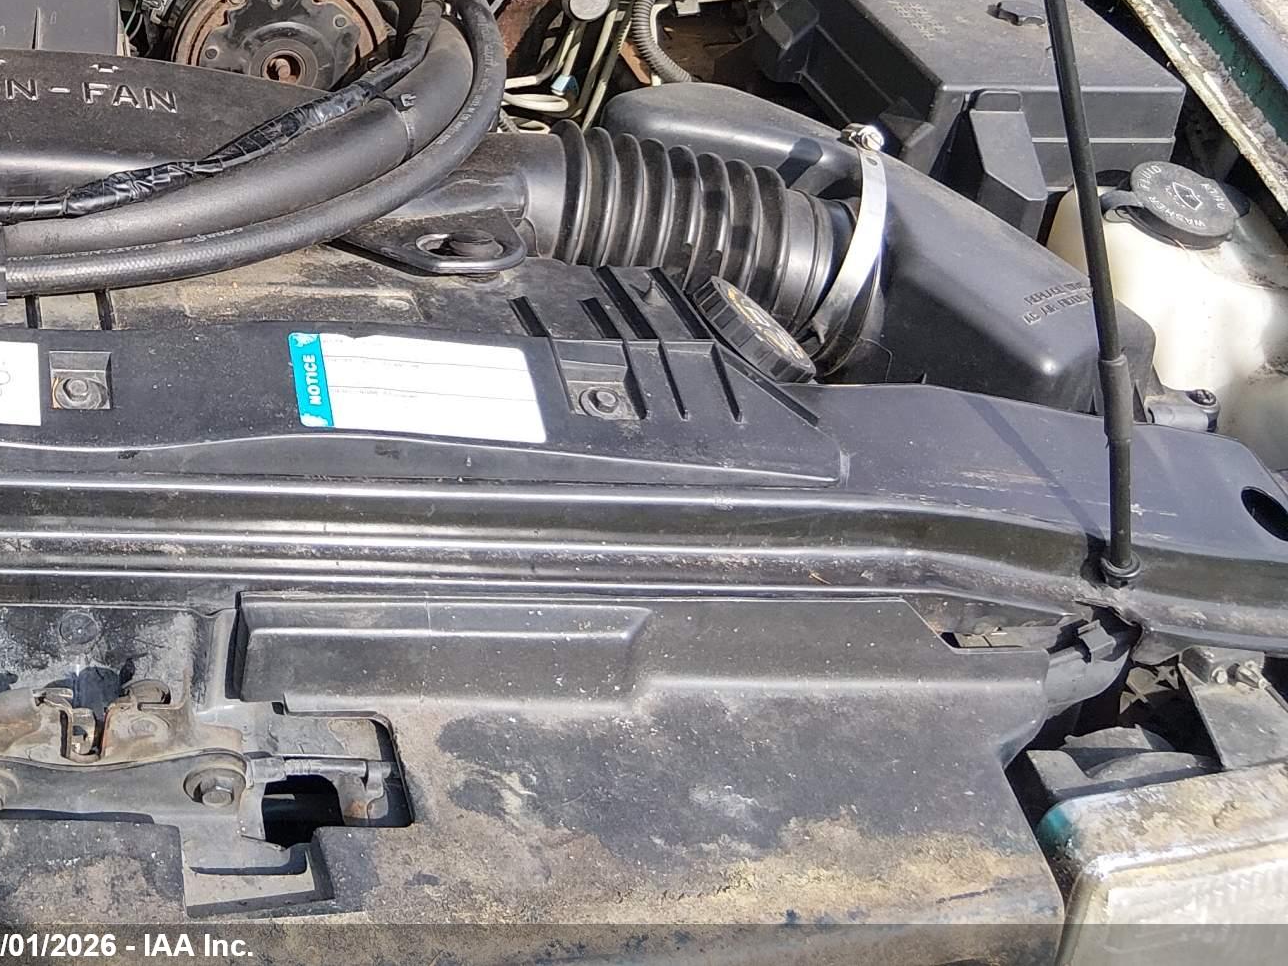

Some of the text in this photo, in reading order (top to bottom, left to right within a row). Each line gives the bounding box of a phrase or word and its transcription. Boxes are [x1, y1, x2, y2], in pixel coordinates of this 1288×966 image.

[81, 81, 178, 114] FAN
[1137, 165, 1162, 191] FLUID
[302, 353, 322, 407] NOTICE
